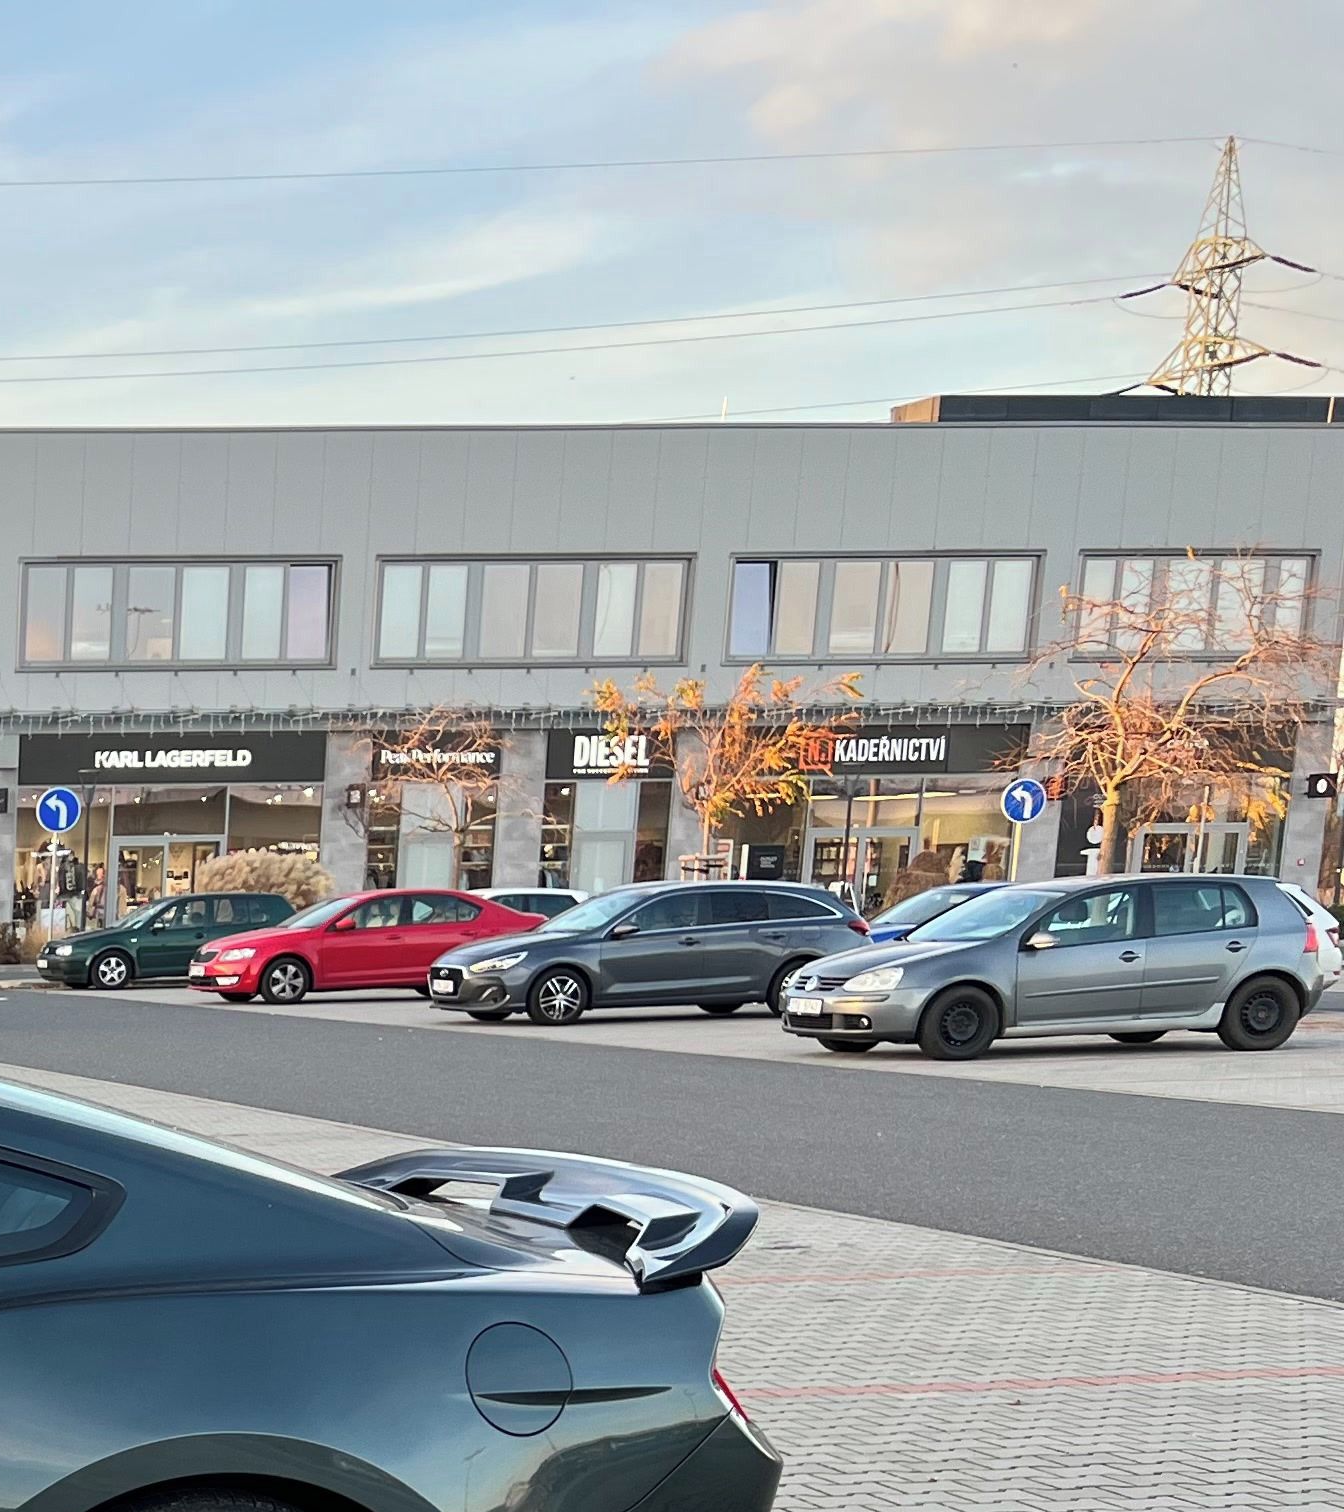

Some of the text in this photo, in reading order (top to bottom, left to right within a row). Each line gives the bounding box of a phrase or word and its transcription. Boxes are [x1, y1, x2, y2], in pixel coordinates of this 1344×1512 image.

[94, 749, 252, 768] KARL LAGERFELD
[573, 735, 650, 768] DIESEL
[834, 735, 946, 763] KADEŘNICTVÍ
